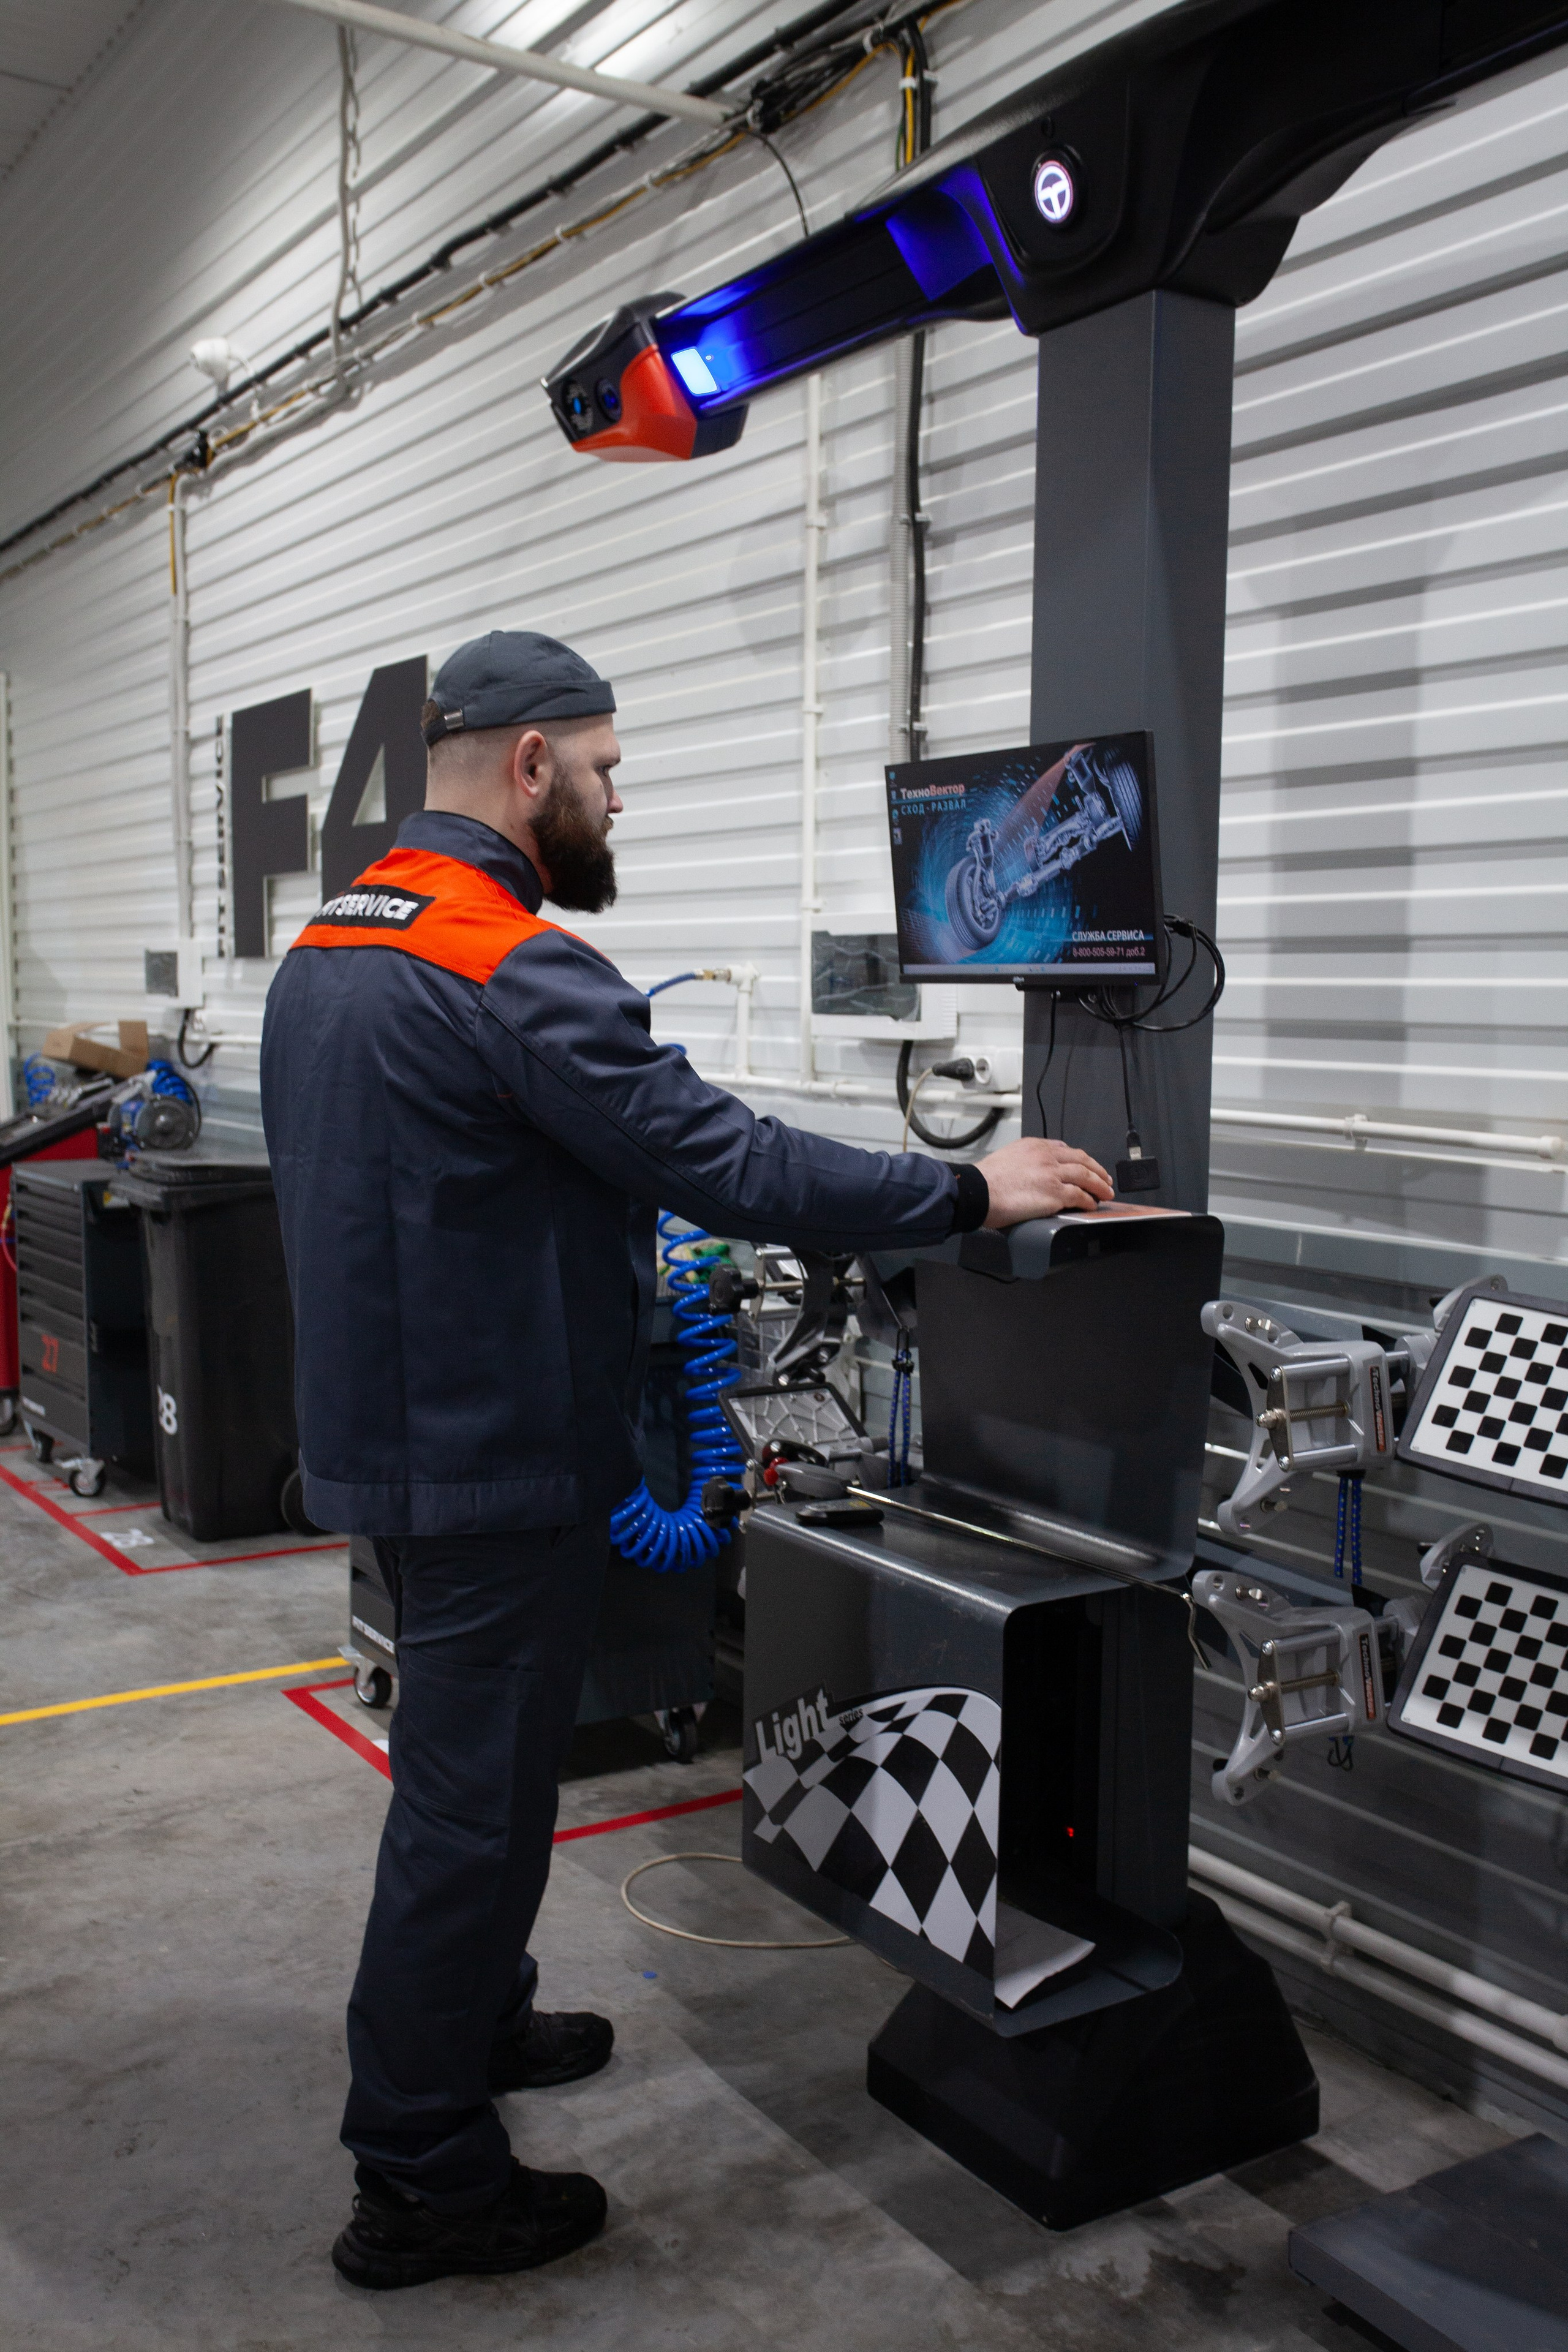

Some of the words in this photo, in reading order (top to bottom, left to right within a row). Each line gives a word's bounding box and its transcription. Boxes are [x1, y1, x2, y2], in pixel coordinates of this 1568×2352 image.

[900, 784, 965, 800] ТехноВектор
[1072, 930, 1106, 942] СЛУЖБА
[1107, 929, 1145, 941] СЕРВИСА
[839, 1708, 864, 1725] series
[755, 1688, 829, 1763] Light
